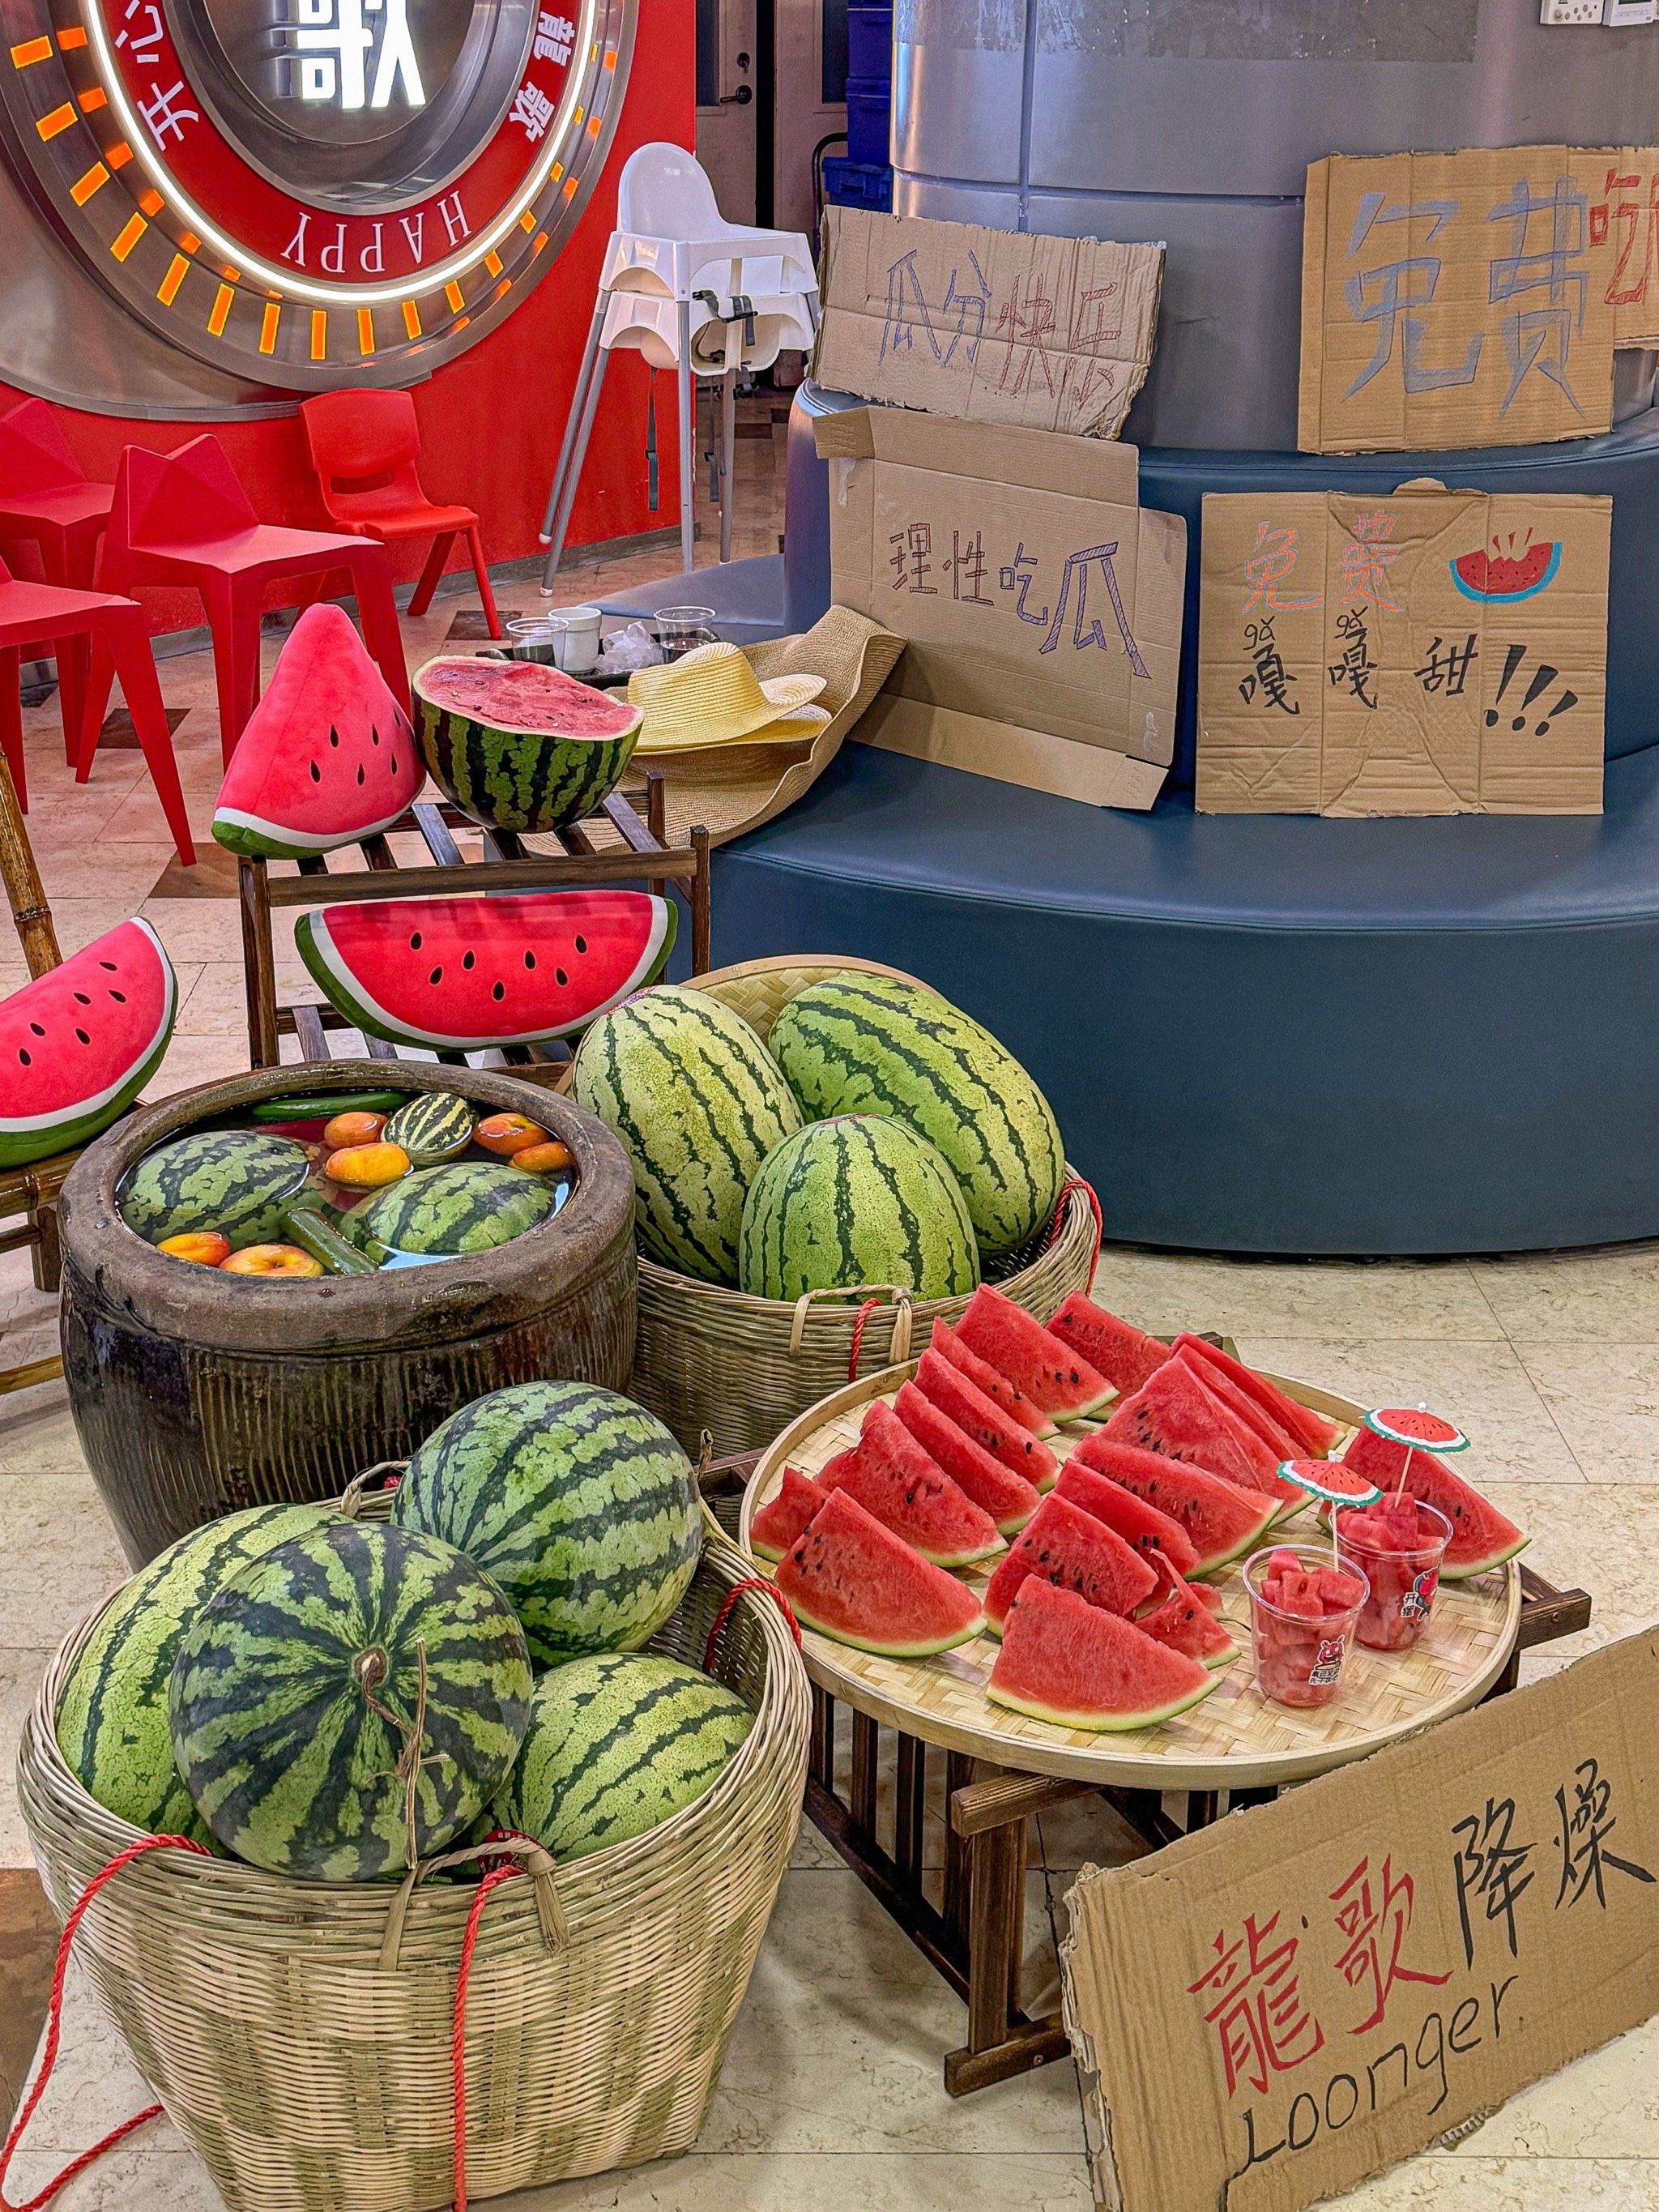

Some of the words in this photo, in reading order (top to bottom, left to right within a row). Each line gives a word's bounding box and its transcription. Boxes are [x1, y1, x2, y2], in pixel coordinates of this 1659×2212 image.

[114, 0, 199, 152] 开心
[509, 11, 575, 143] 龍歌
[280, 190, 472, 273] HAPPY
[889, 523, 1152, 679] 理性吃瓜
[1242, 509, 1403, 613] 免费
[1242, 1975, 1519, 2165] Loonger
